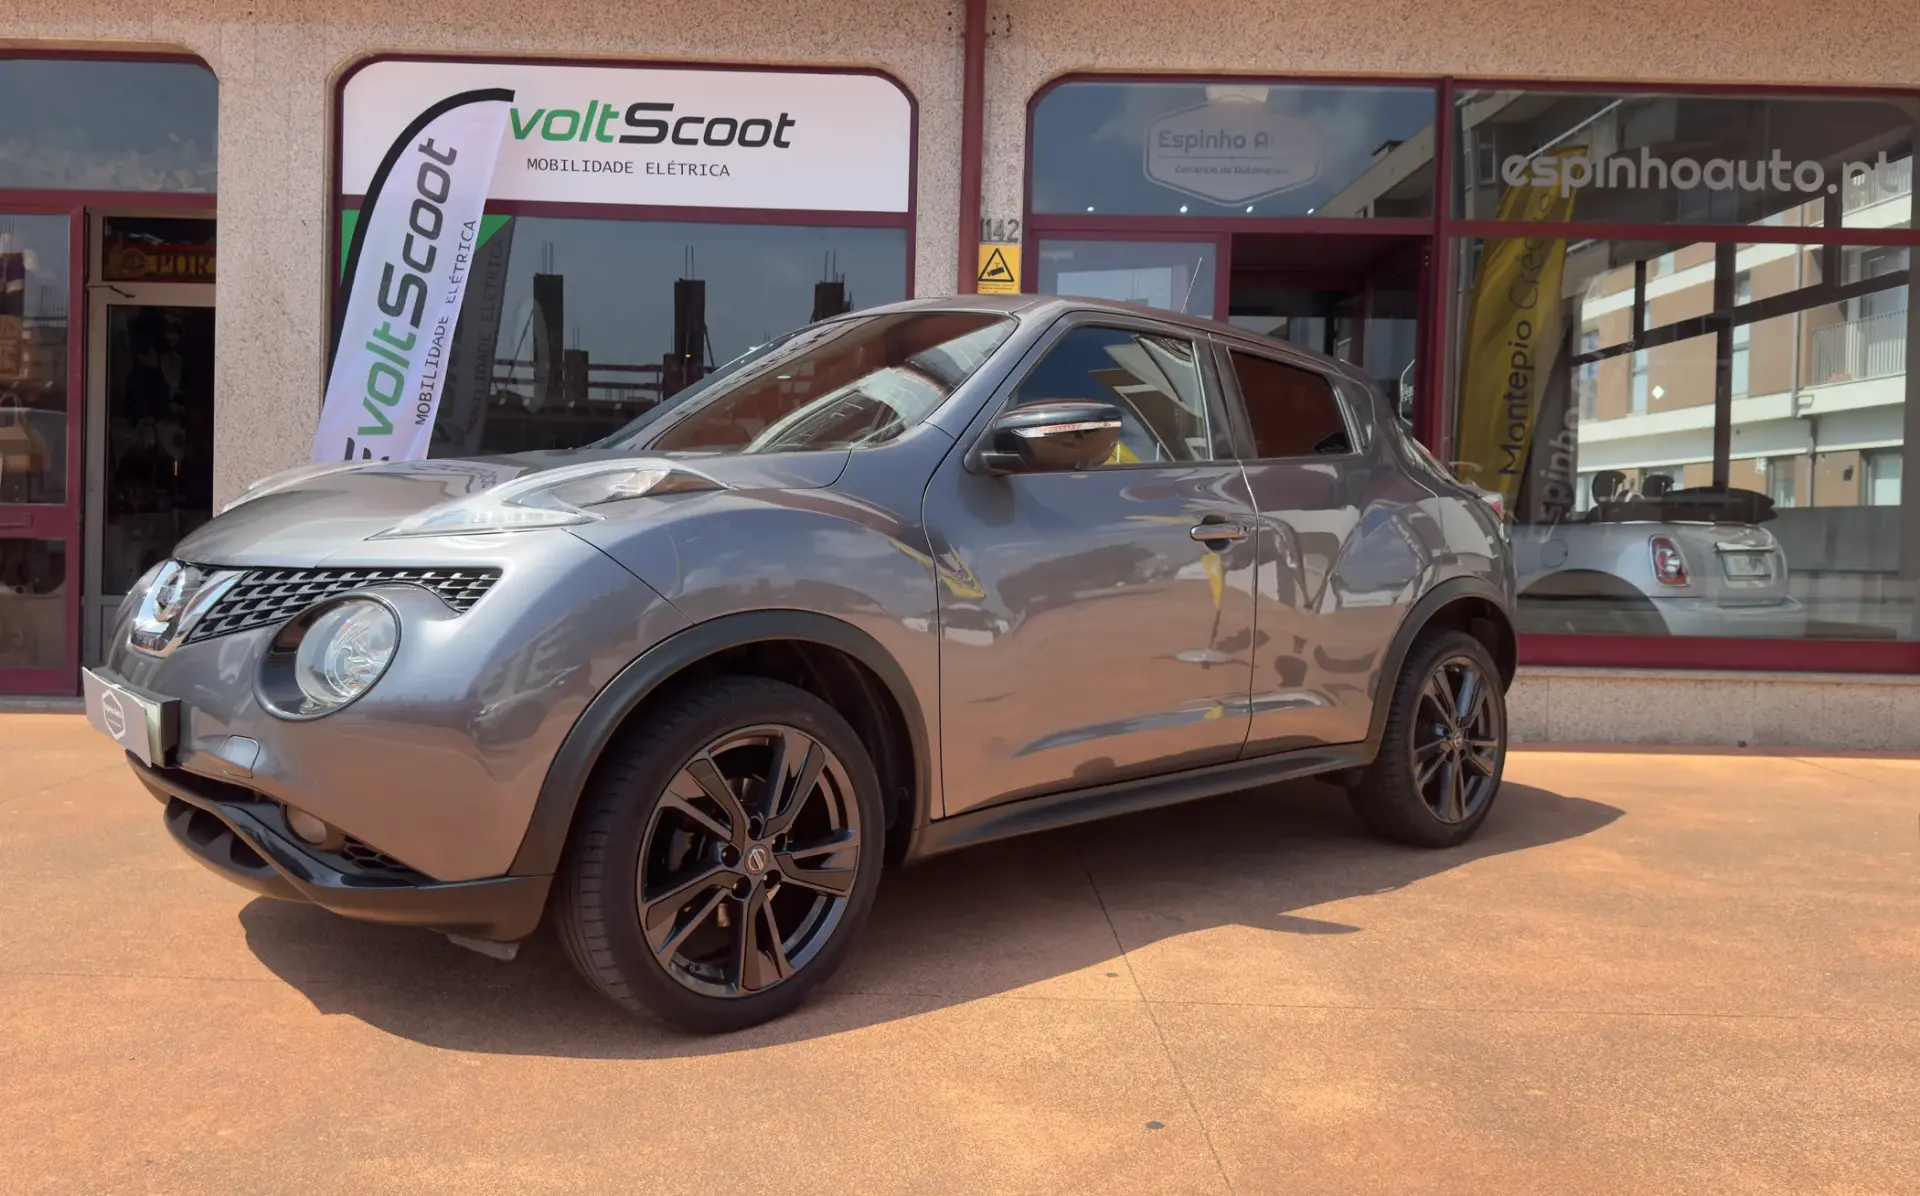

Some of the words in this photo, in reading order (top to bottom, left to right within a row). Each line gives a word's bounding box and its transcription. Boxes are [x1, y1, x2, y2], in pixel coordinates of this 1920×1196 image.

[509, 100, 796, 149] voltScoot
[527, 157, 634, 175] MOBILIDADE
[645, 160, 730, 177] ELÉTRICA
[1158, 129, 1247, 153] Espinho
[1501, 146, 1899, 208] espinhoauto.pt
[356, 137, 458, 436] voltScoot
[1509, 193, 1550, 309] Créo
[415, 315, 449, 426] MOBILIDADE
[445, 220, 477, 304] ELÉTRICA
[1498, 319, 1535, 476] Montepio
